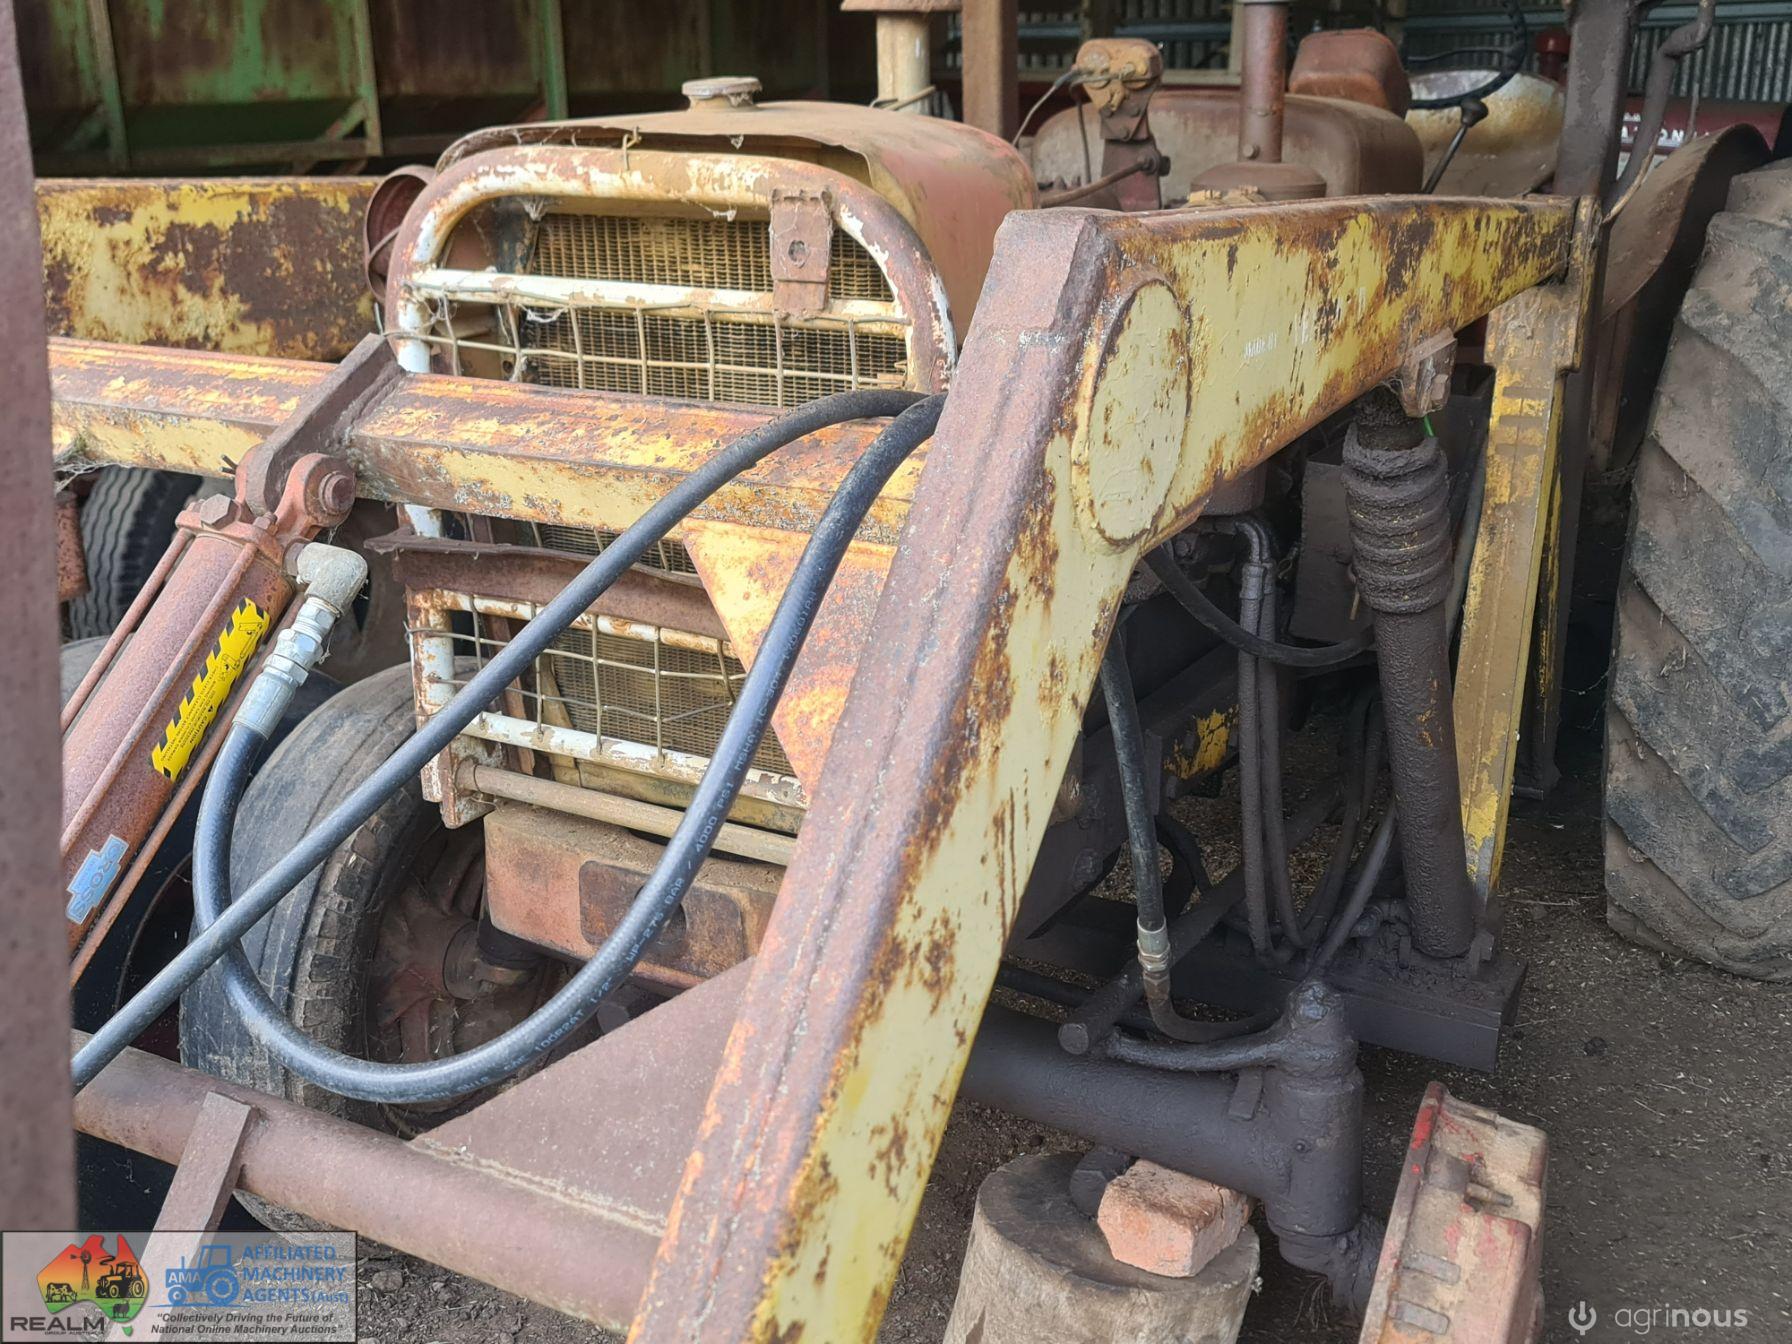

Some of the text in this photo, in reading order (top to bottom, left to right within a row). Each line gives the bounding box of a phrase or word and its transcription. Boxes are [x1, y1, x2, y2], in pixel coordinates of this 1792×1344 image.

[189, 715, 208, 744] CAUTION
[664, 877, 685, 906] BAR
[694, 815, 718, 853] 4000
[714, 780, 734, 809] PSI
[734, 733, 756, 771] MSHA
